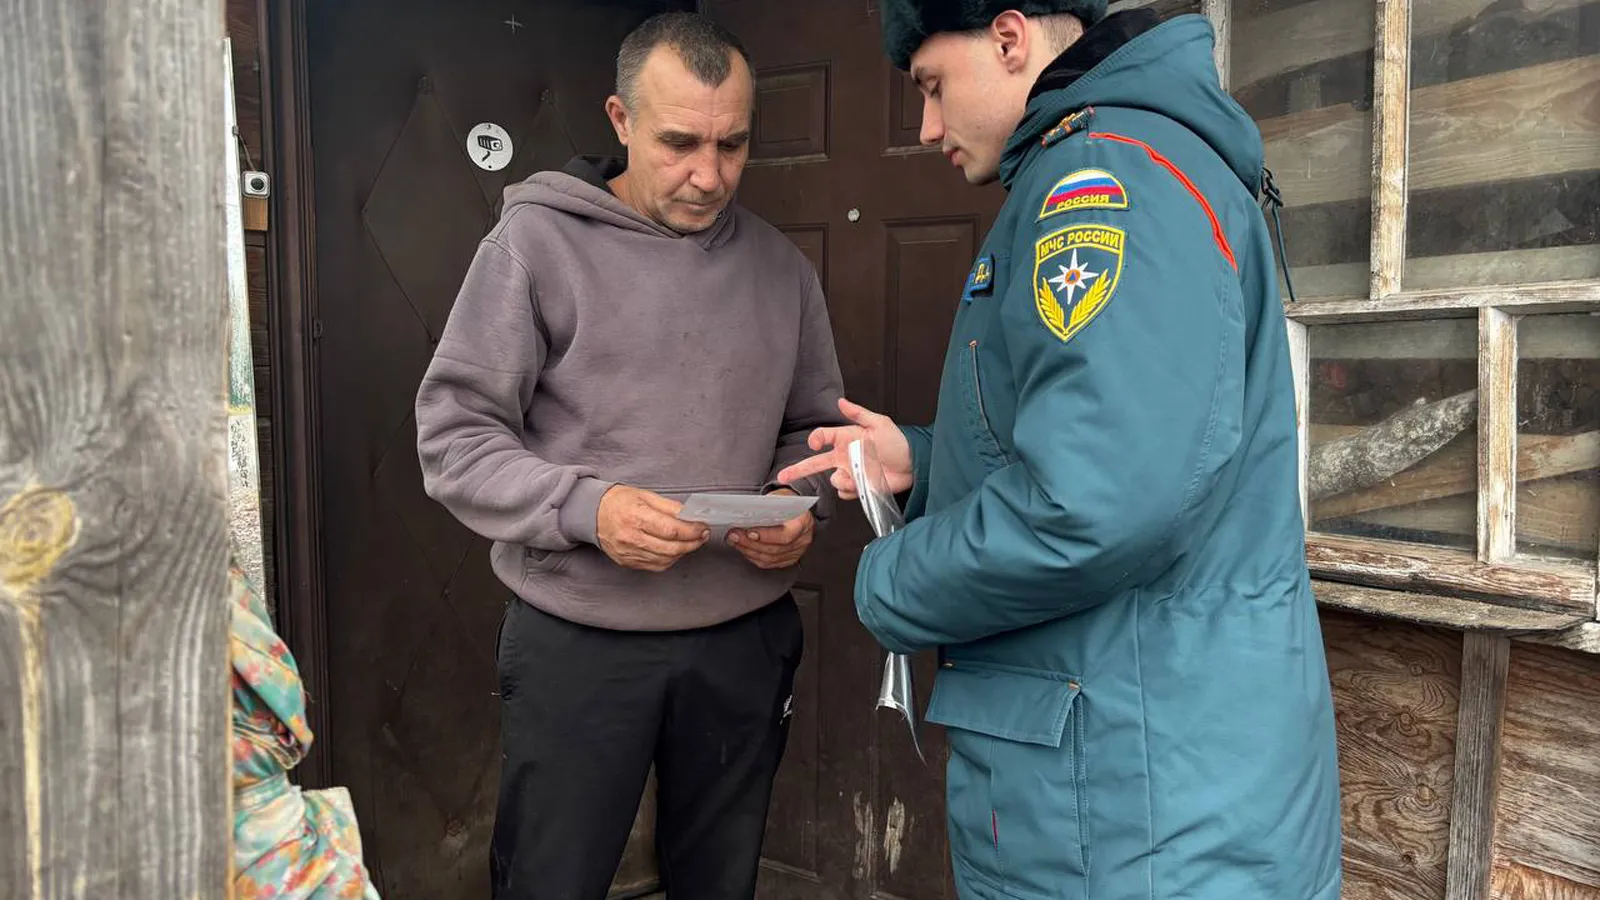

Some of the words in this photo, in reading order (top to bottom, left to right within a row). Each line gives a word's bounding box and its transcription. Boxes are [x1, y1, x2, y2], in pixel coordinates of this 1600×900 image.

[1056, 194, 1110, 210] РОССИЯ
[1040, 235, 1065, 257] МЧС
[1067, 230, 1119, 248] РОССИИ
